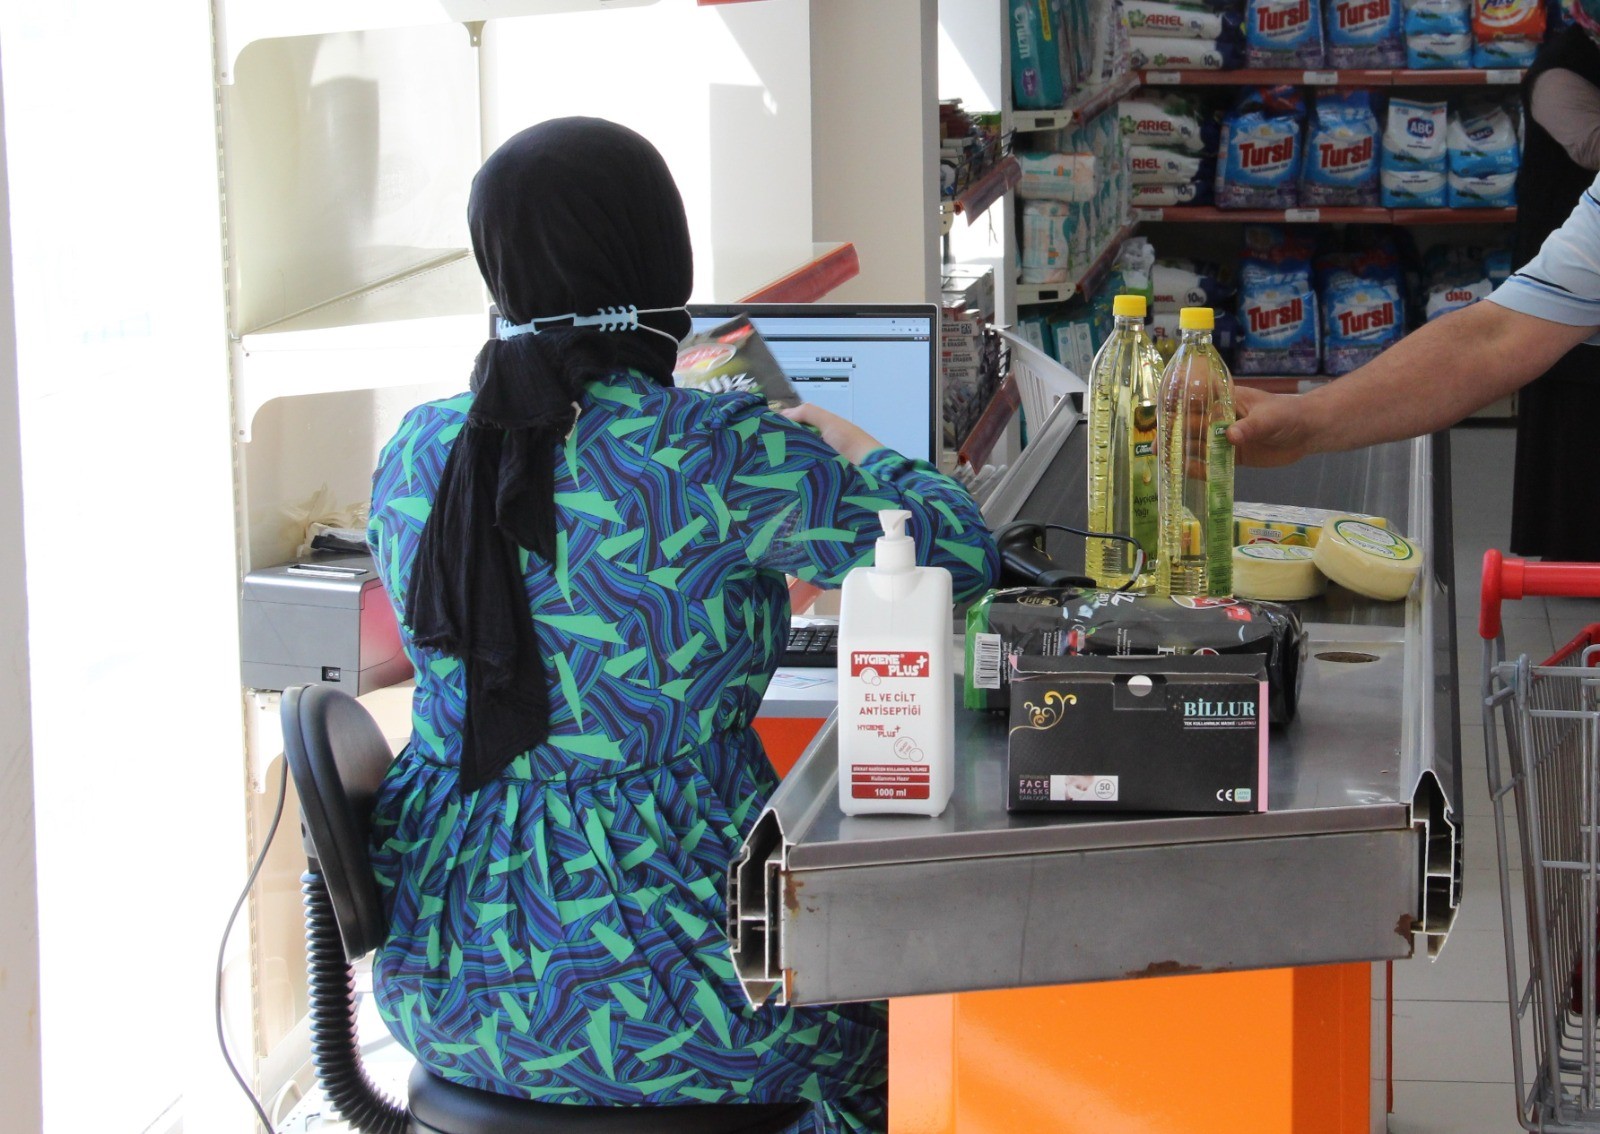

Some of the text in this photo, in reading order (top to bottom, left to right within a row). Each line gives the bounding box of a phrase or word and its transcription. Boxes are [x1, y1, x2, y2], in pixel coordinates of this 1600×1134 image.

[1146, 13, 1184, 27] ARIEL
[1137, 119, 1174, 132] ARIEL
[1410, 121, 1433, 135] ABC
[1445, 291, 1473, 302] OMO
[854, 654, 900, 665] HYGIENE
[865, 691, 916, 702] EL VE CİLT
[859, 705, 921, 716] ANTİSEPTİĞİ
[1020, 780, 1049, 788] FACE
[875, 788, 907, 797] 1000 ml
